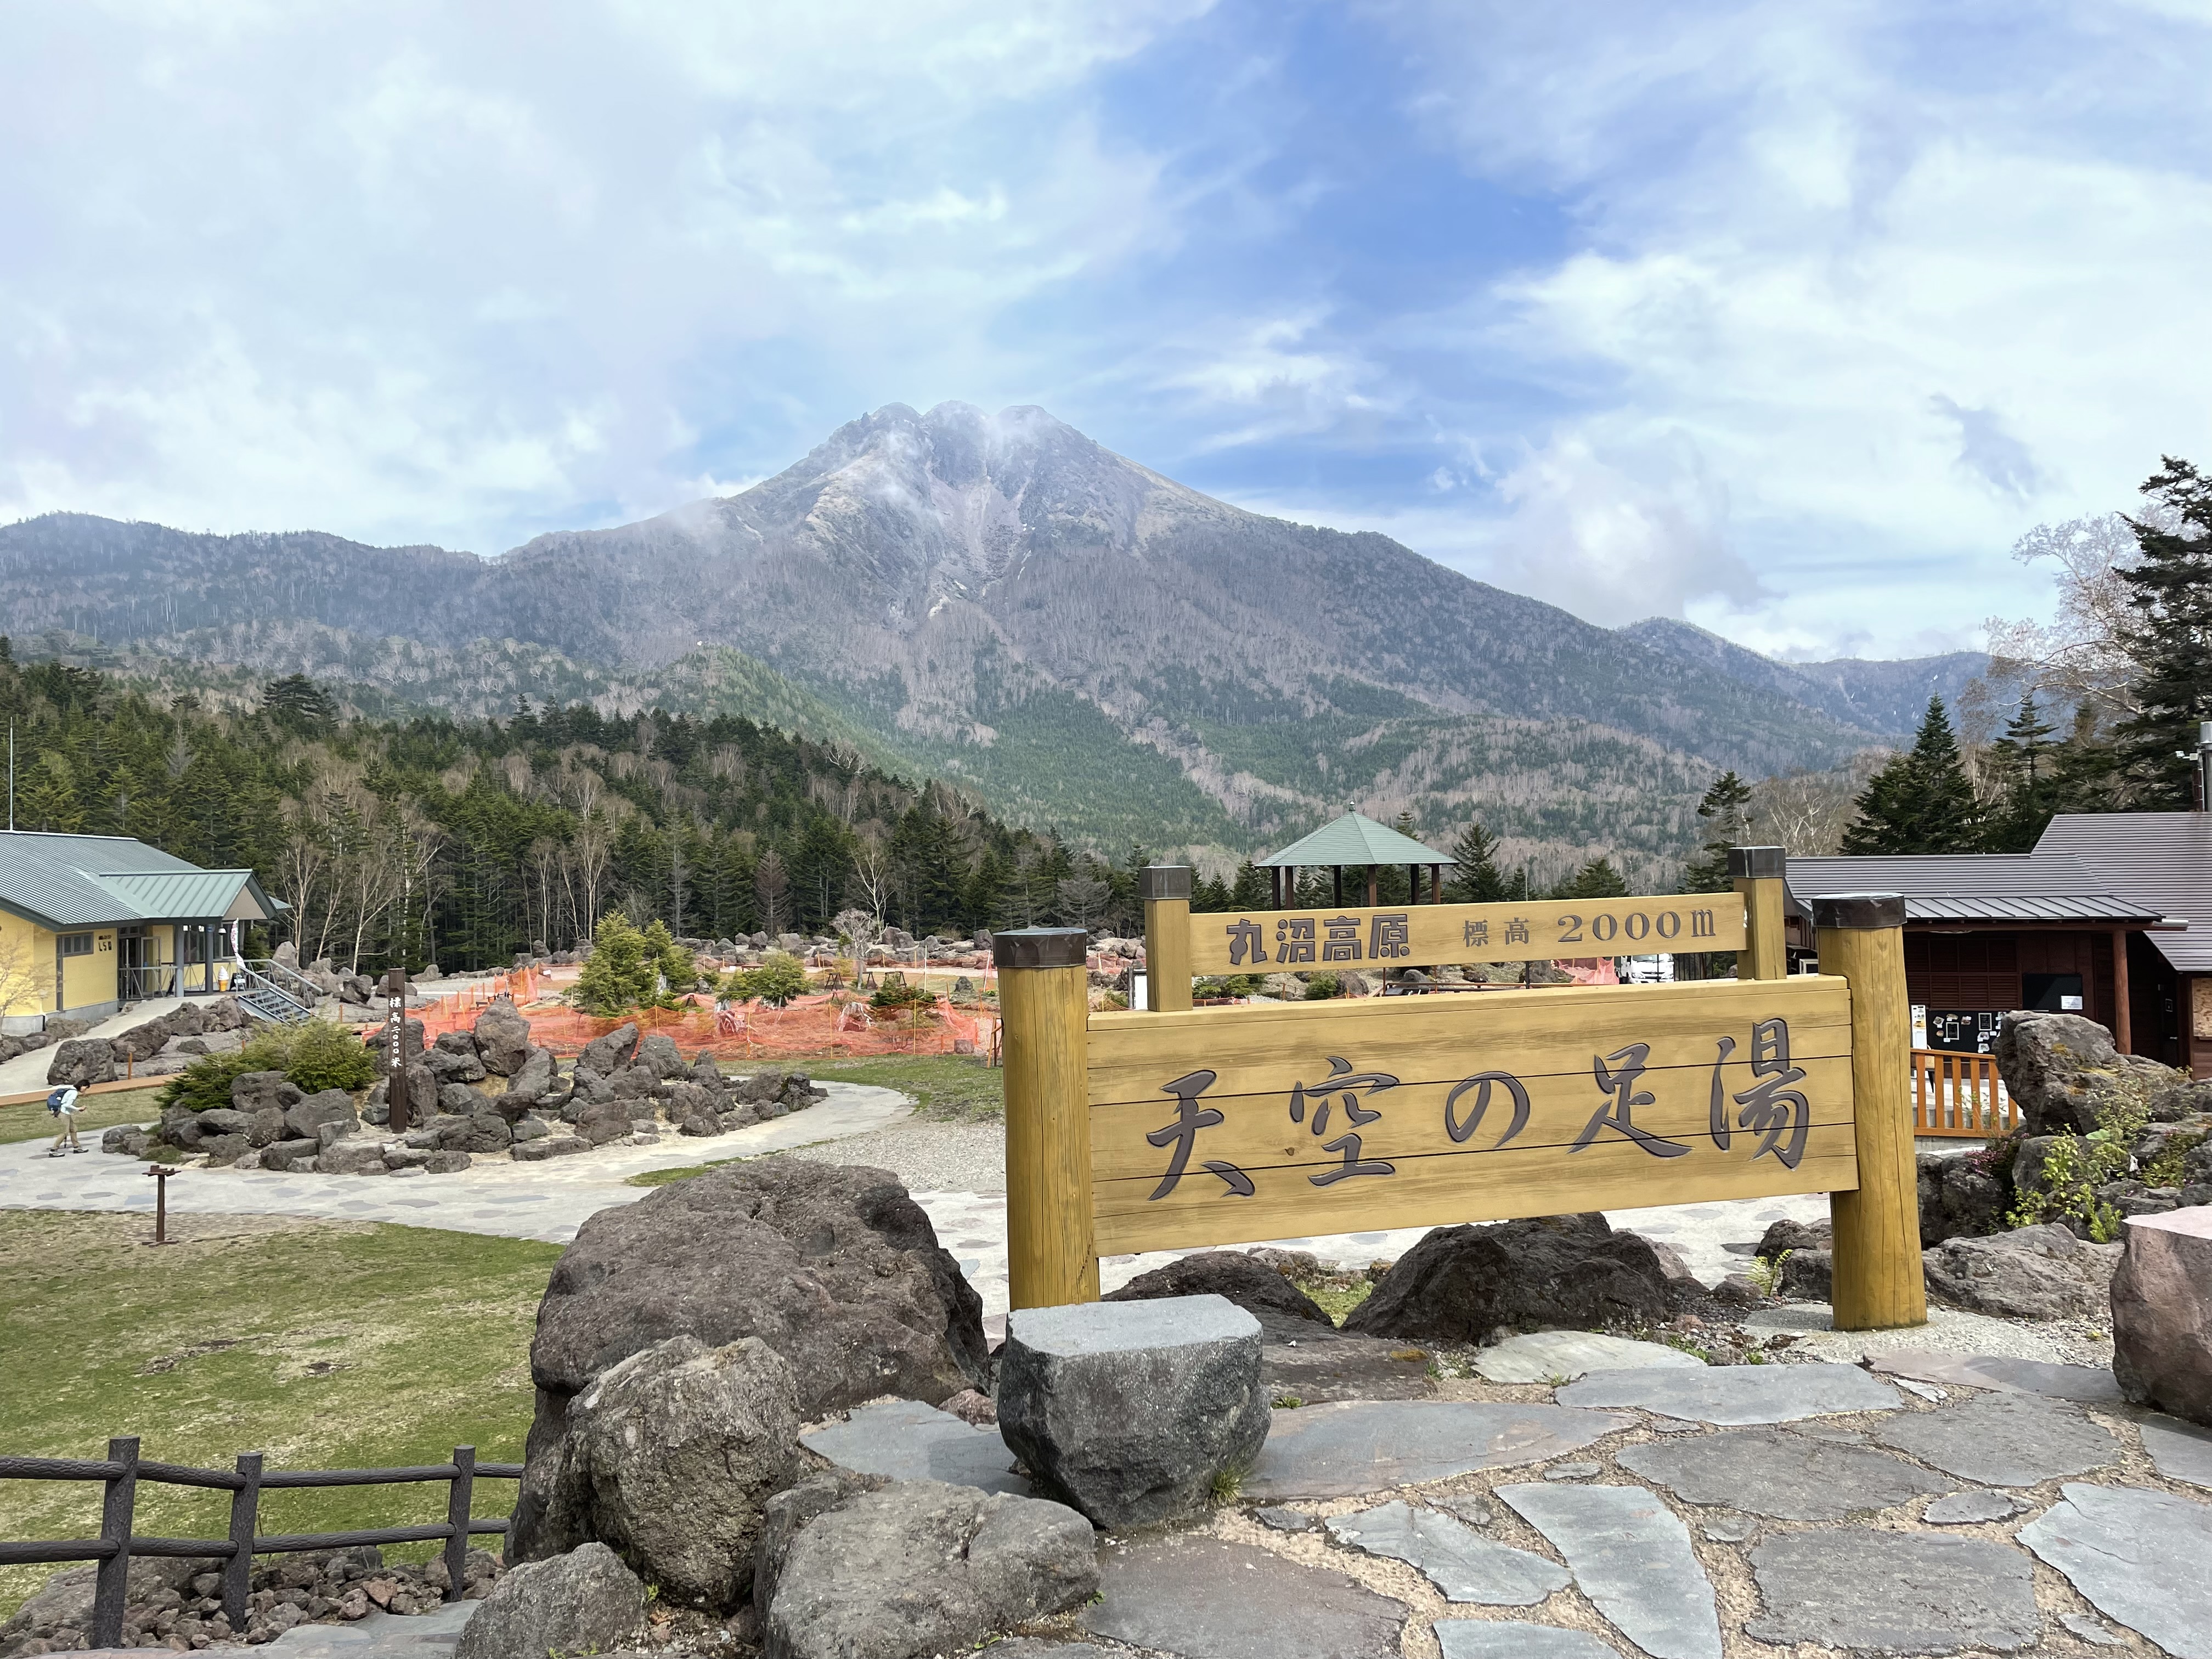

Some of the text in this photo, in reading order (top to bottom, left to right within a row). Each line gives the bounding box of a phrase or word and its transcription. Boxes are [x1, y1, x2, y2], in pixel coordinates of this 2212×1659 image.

[1226, 913, 1410, 966] 丸沼高原
[1146, 1018, 1810, 1201] 天空の足湯
